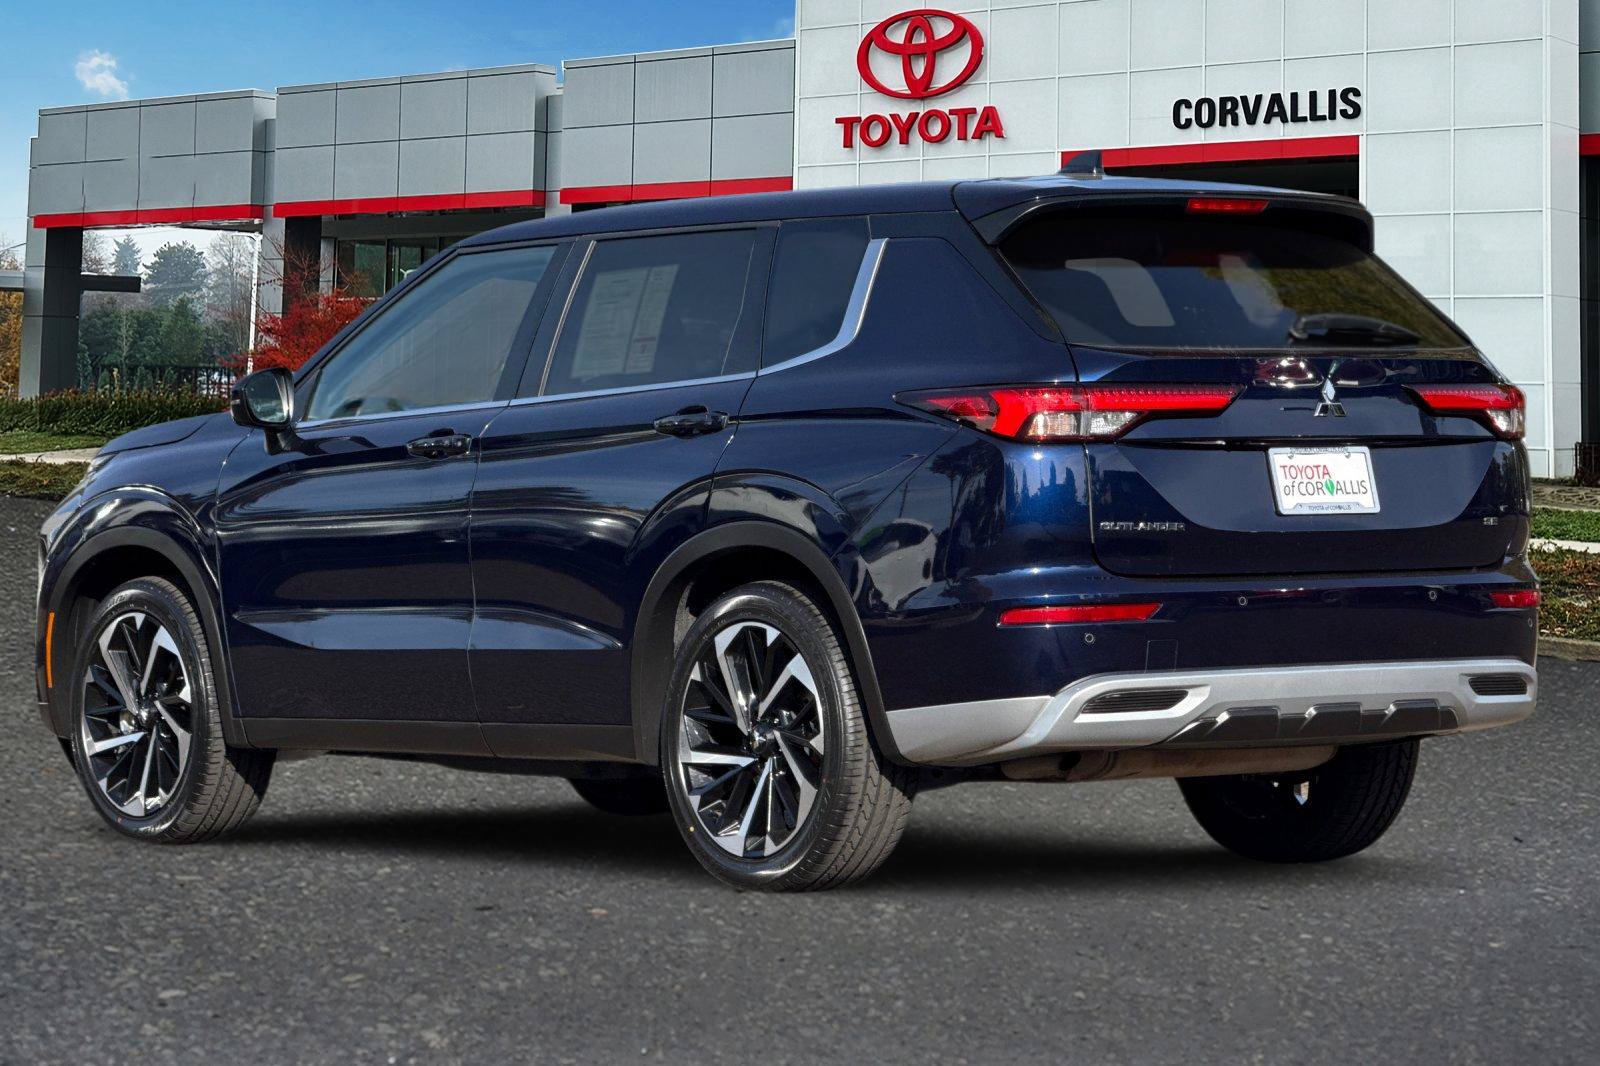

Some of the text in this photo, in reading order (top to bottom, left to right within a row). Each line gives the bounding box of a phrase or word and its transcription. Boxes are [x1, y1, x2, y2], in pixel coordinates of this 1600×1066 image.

[1173, 87, 1362, 129] CORVALLIS
[835, 105, 1005, 148] TOYOTA
[1280, 465, 1332, 480] TOYOTA
[1100, 521, 1185, 531] OUTLANDER
